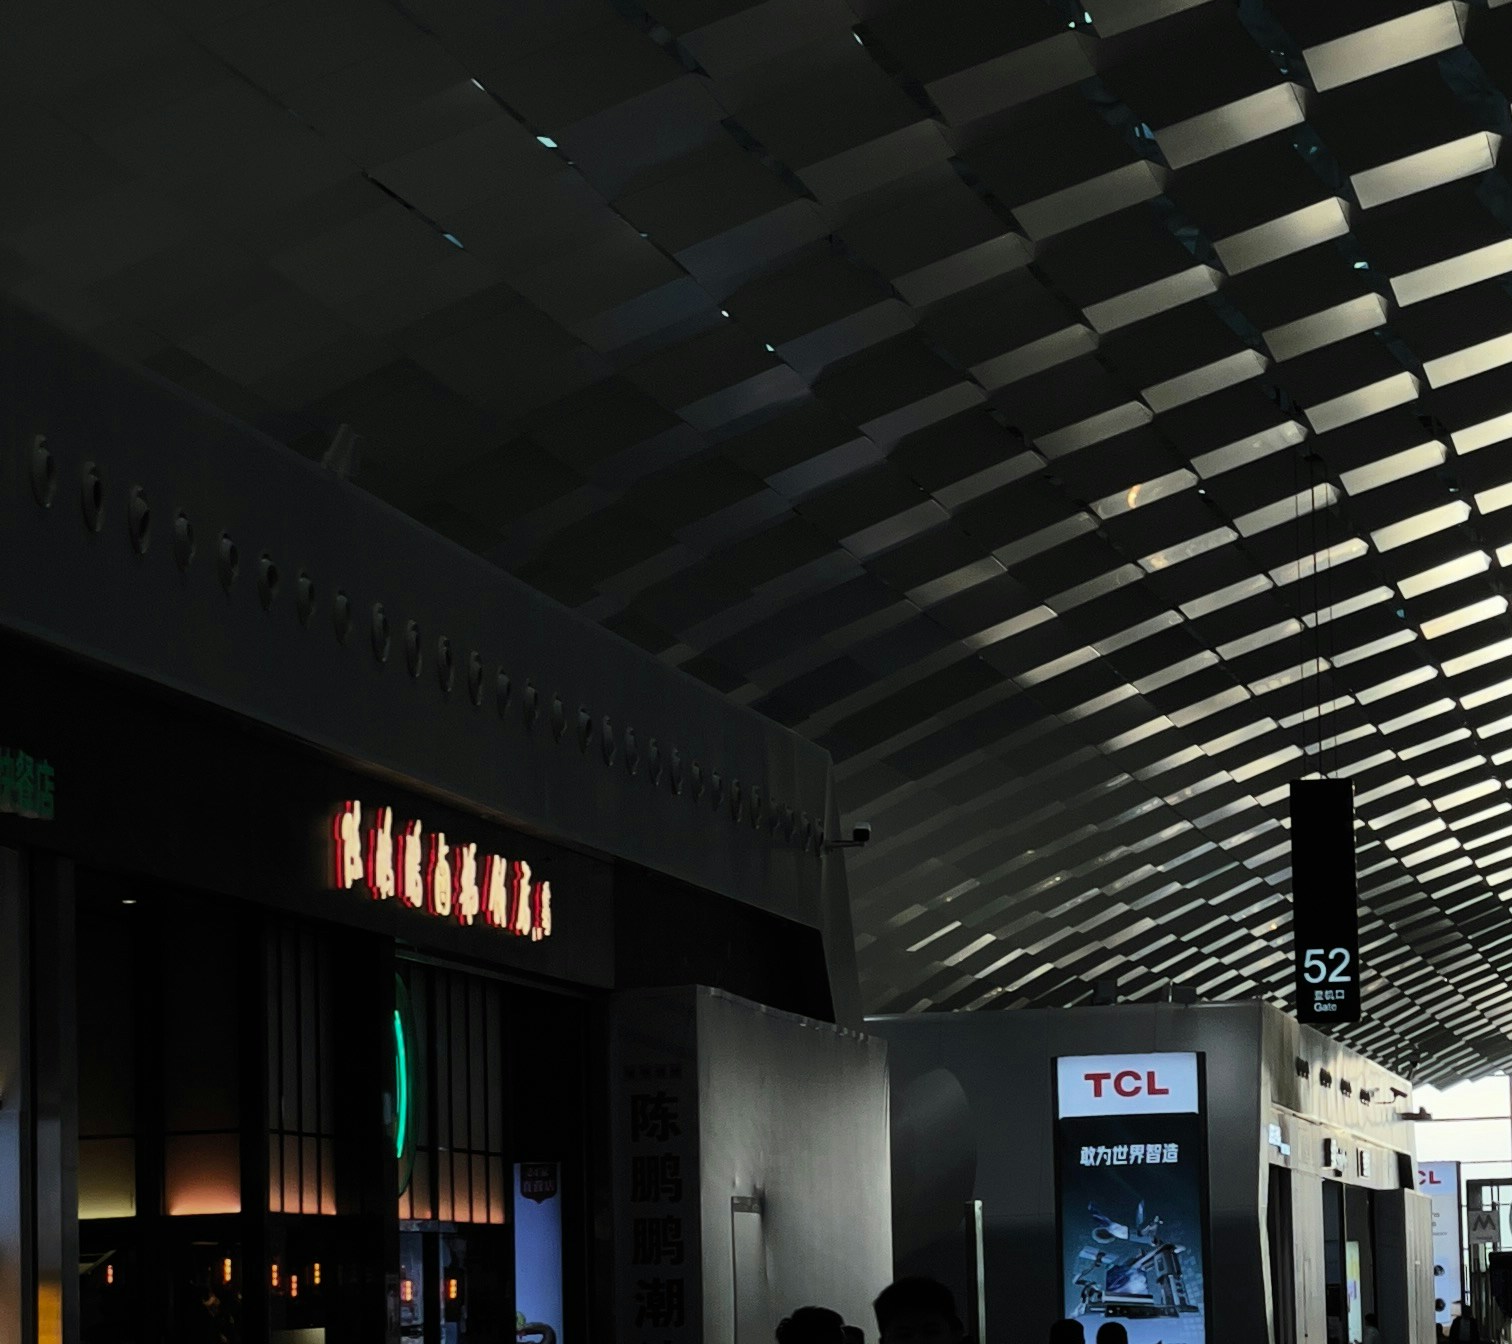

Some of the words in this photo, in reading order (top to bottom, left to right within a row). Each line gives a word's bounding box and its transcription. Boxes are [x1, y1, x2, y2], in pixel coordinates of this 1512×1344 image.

[1303, 947, 1352, 984] 52
[1313, 989, 1345, 1001] 登机口
[1313, 1002, 1338, 1013] Gate
[1084, 1070, 1169, 1097] TCL
[1080, 1142, 1179, 1167] 敢为世界智造
